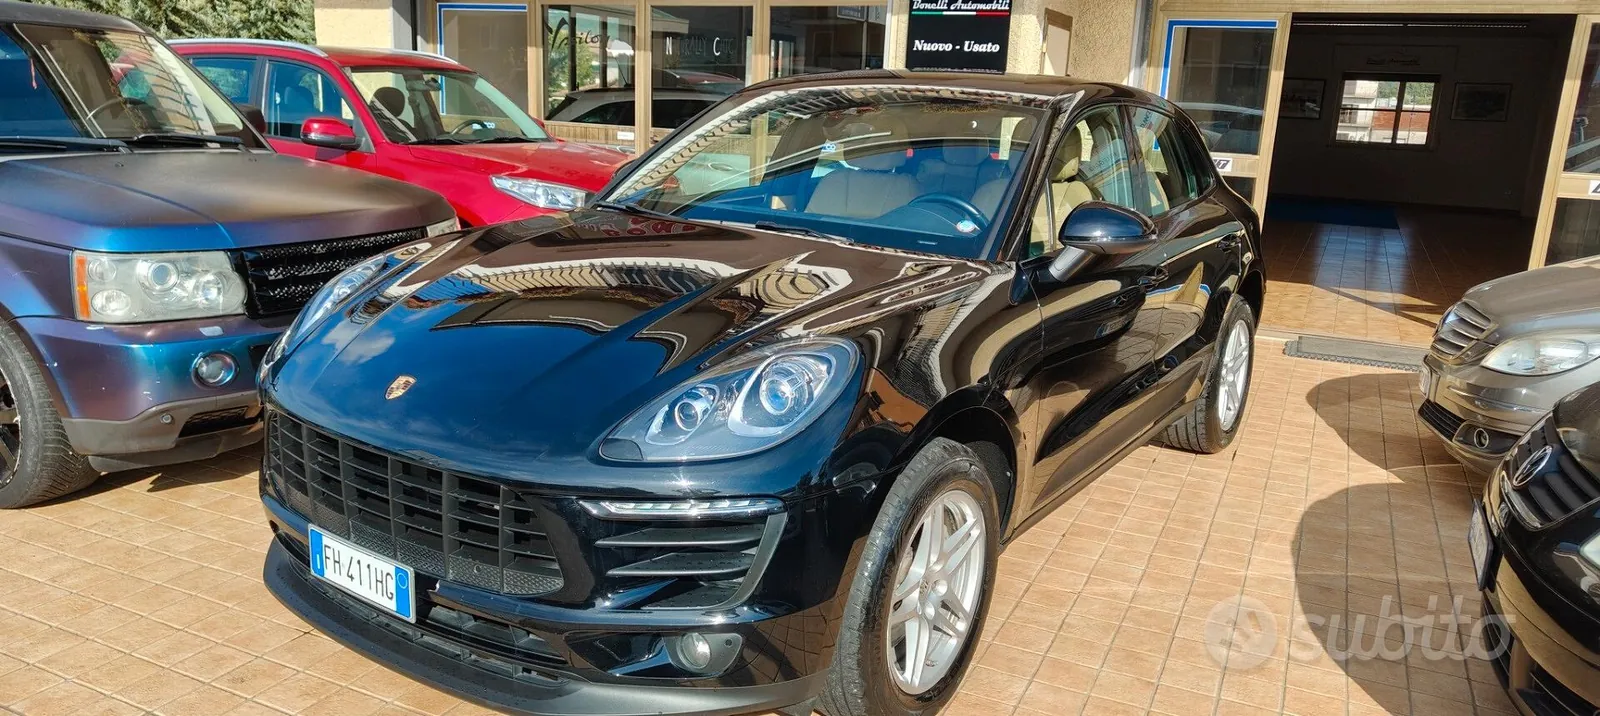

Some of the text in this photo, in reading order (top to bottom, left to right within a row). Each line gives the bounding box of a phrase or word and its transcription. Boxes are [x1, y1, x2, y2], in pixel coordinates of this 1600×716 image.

[912, 0, 1009, 10] Bonelli Automobili
[912, 39, 953, 52] Nuovo
[963, 40, 1001, 53] Usato
